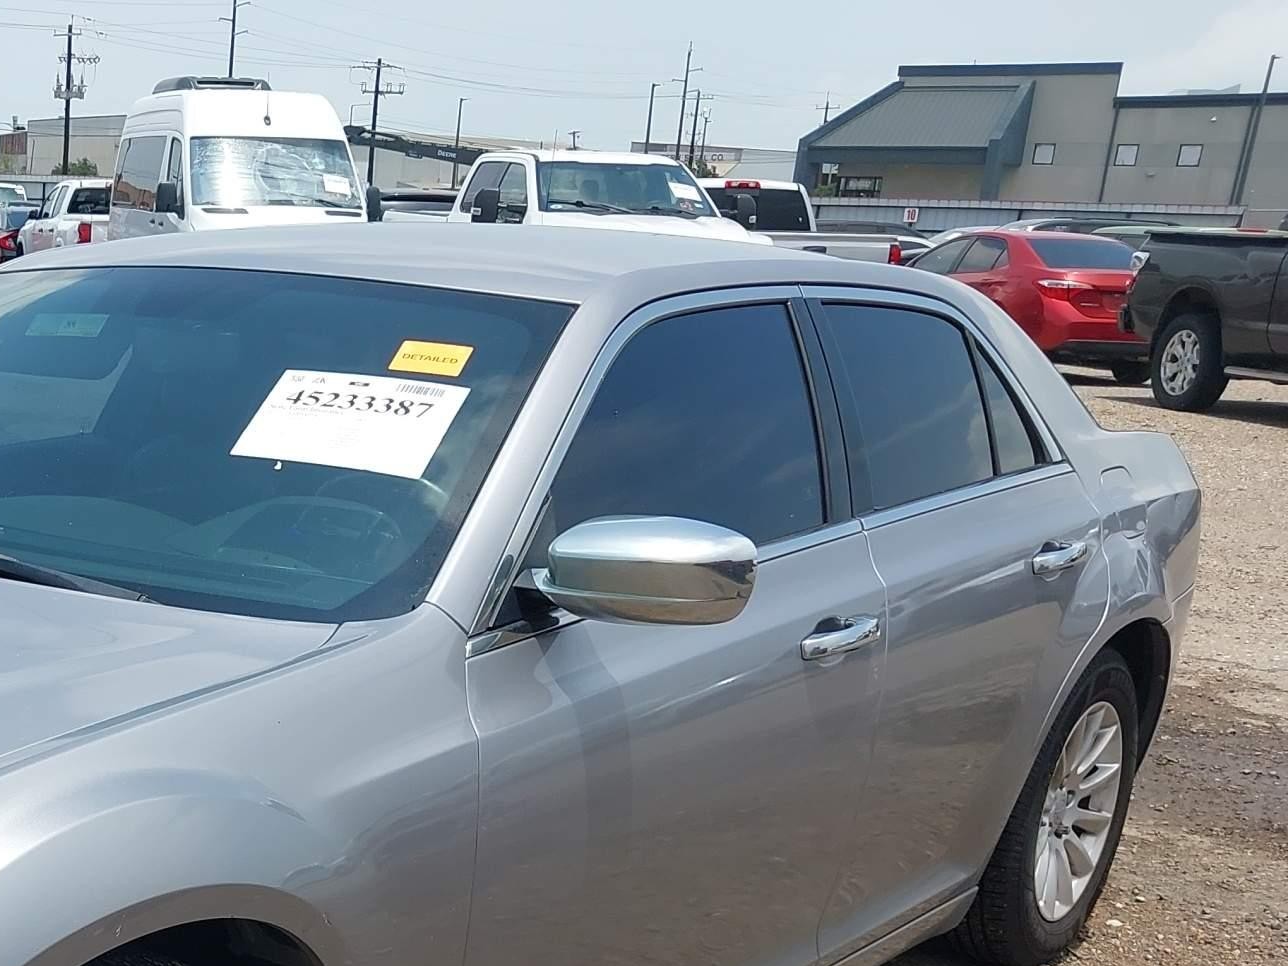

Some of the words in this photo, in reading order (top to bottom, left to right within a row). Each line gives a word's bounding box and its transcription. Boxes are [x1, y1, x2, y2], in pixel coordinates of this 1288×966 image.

[437, 149, 457, 159] DEERE
[907, 209, 917, 221] 10
[402, 352, 458, 365] DETAILED
[286, 389, 435, 418] 45233387
